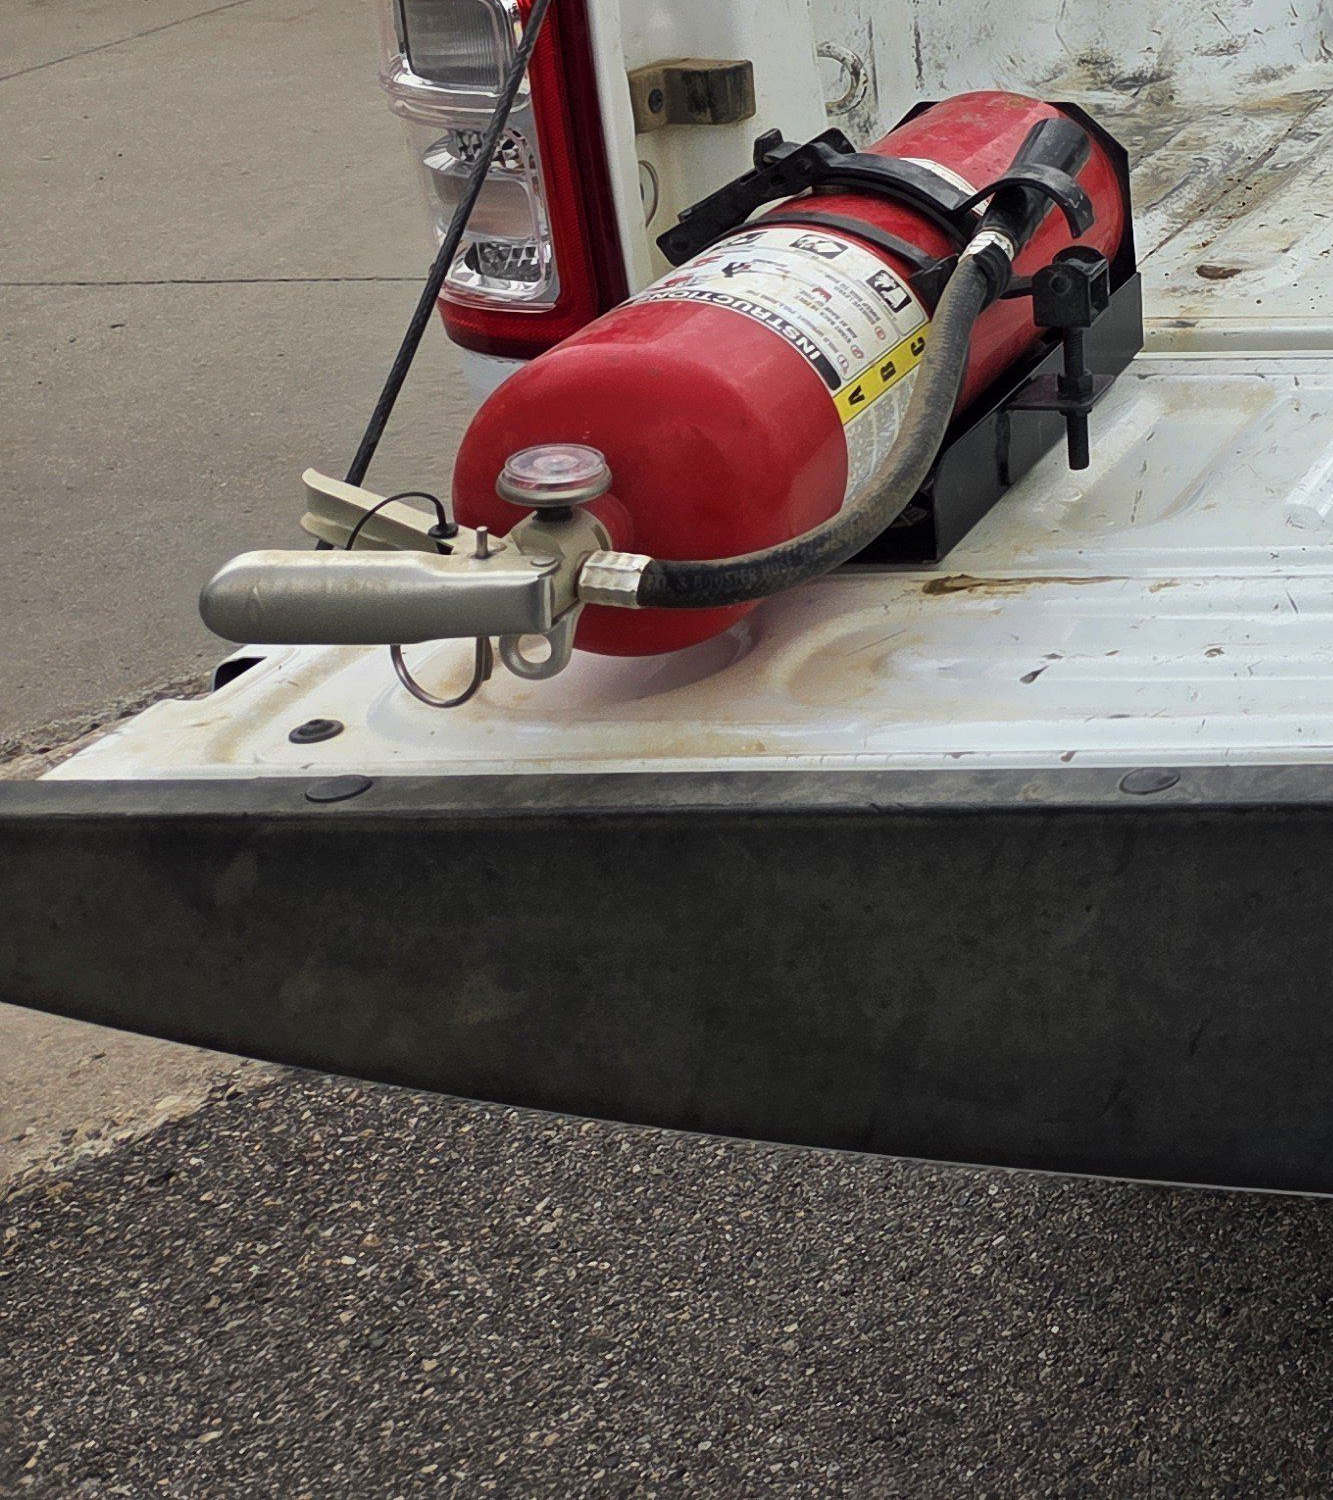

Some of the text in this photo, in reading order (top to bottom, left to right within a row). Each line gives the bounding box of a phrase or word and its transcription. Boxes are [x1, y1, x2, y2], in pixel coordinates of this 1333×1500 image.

[848, 337, 925, 405] A B C
